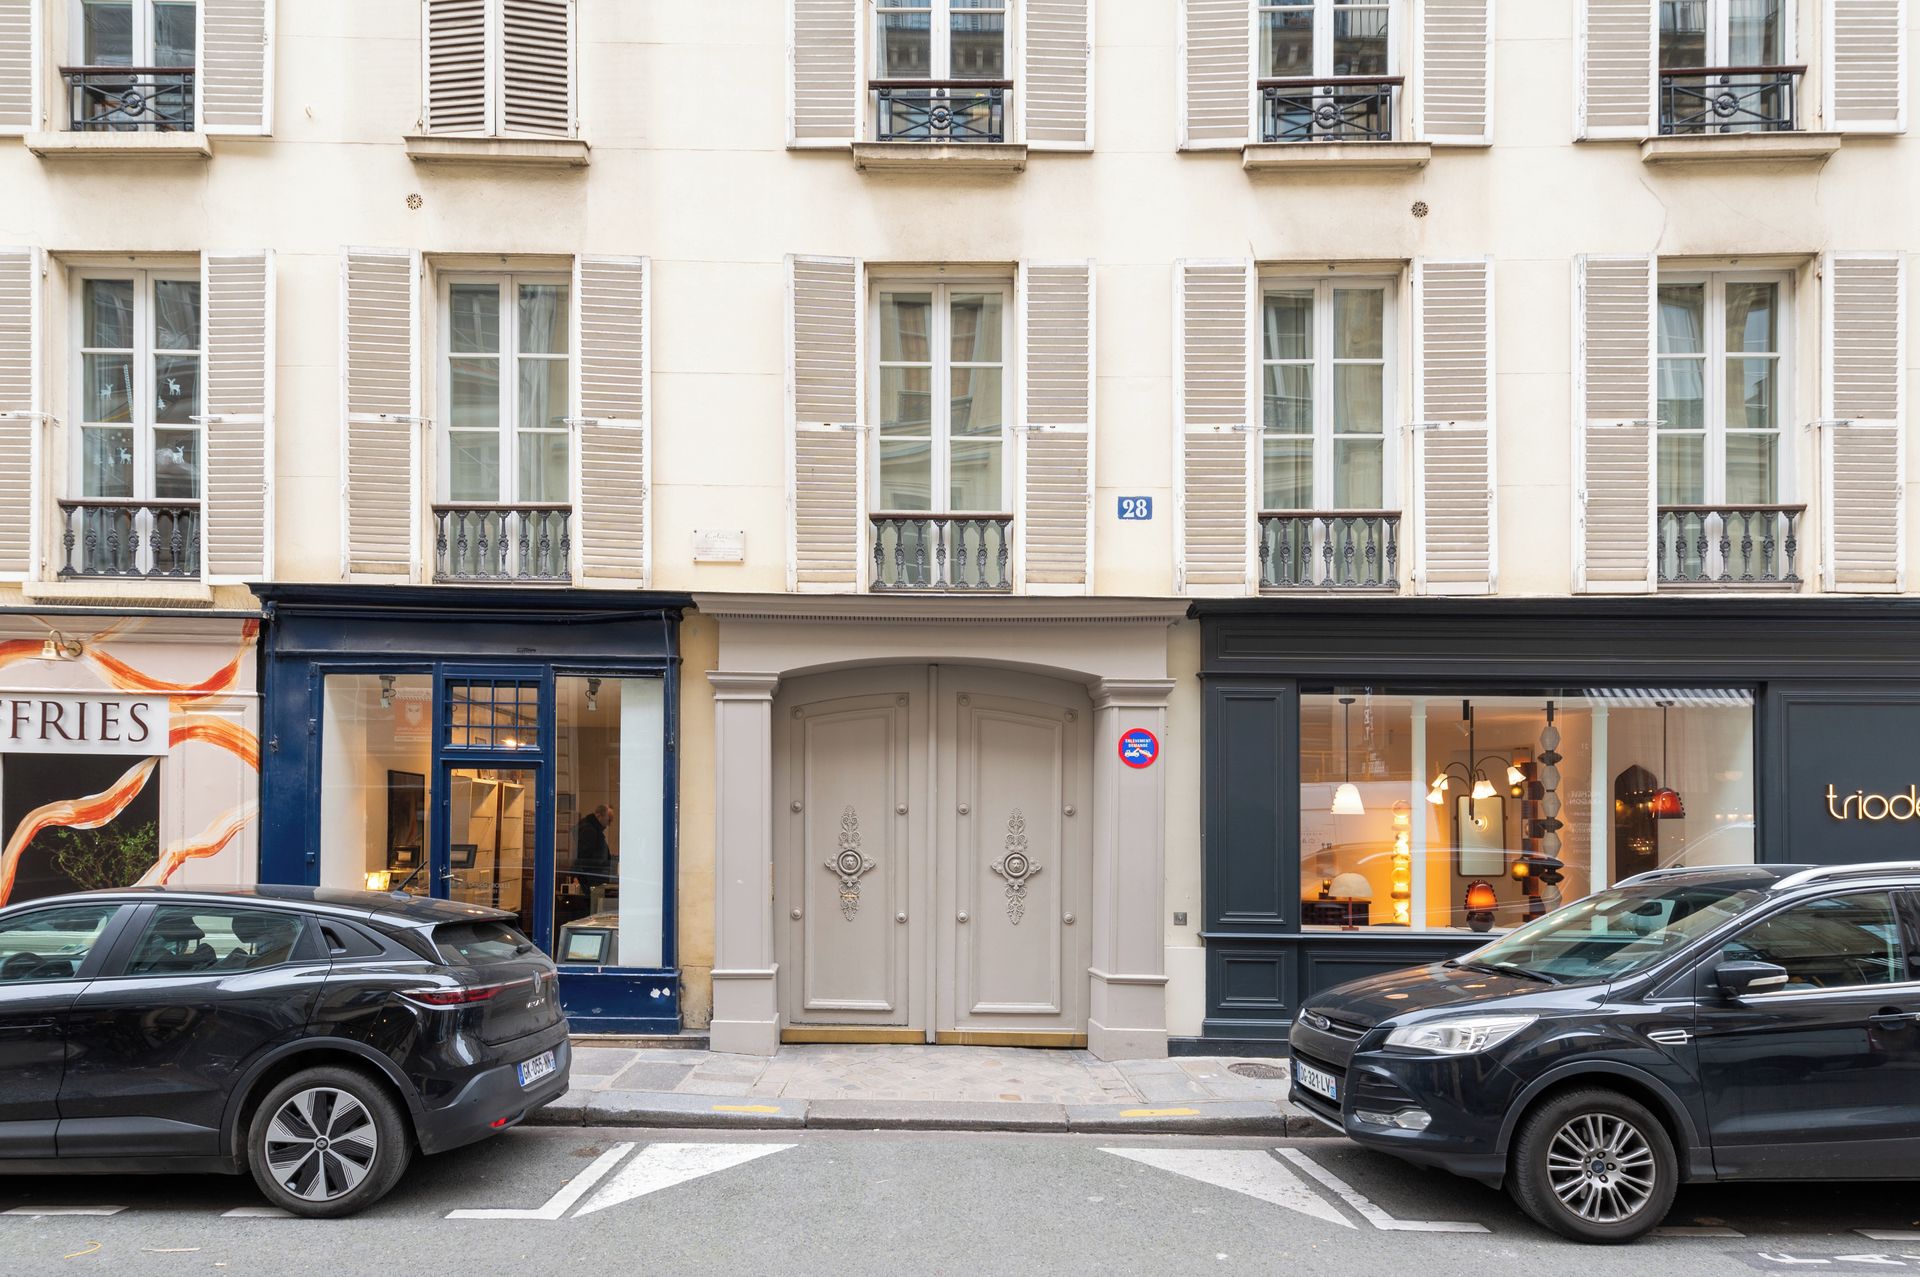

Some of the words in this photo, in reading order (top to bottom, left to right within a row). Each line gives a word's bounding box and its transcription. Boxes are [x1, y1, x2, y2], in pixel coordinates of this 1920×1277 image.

[1122, 499, 1148, 518] 28
[0, 700, 149, 742] FRIES
[1825, 783, 1920, 820] triod
